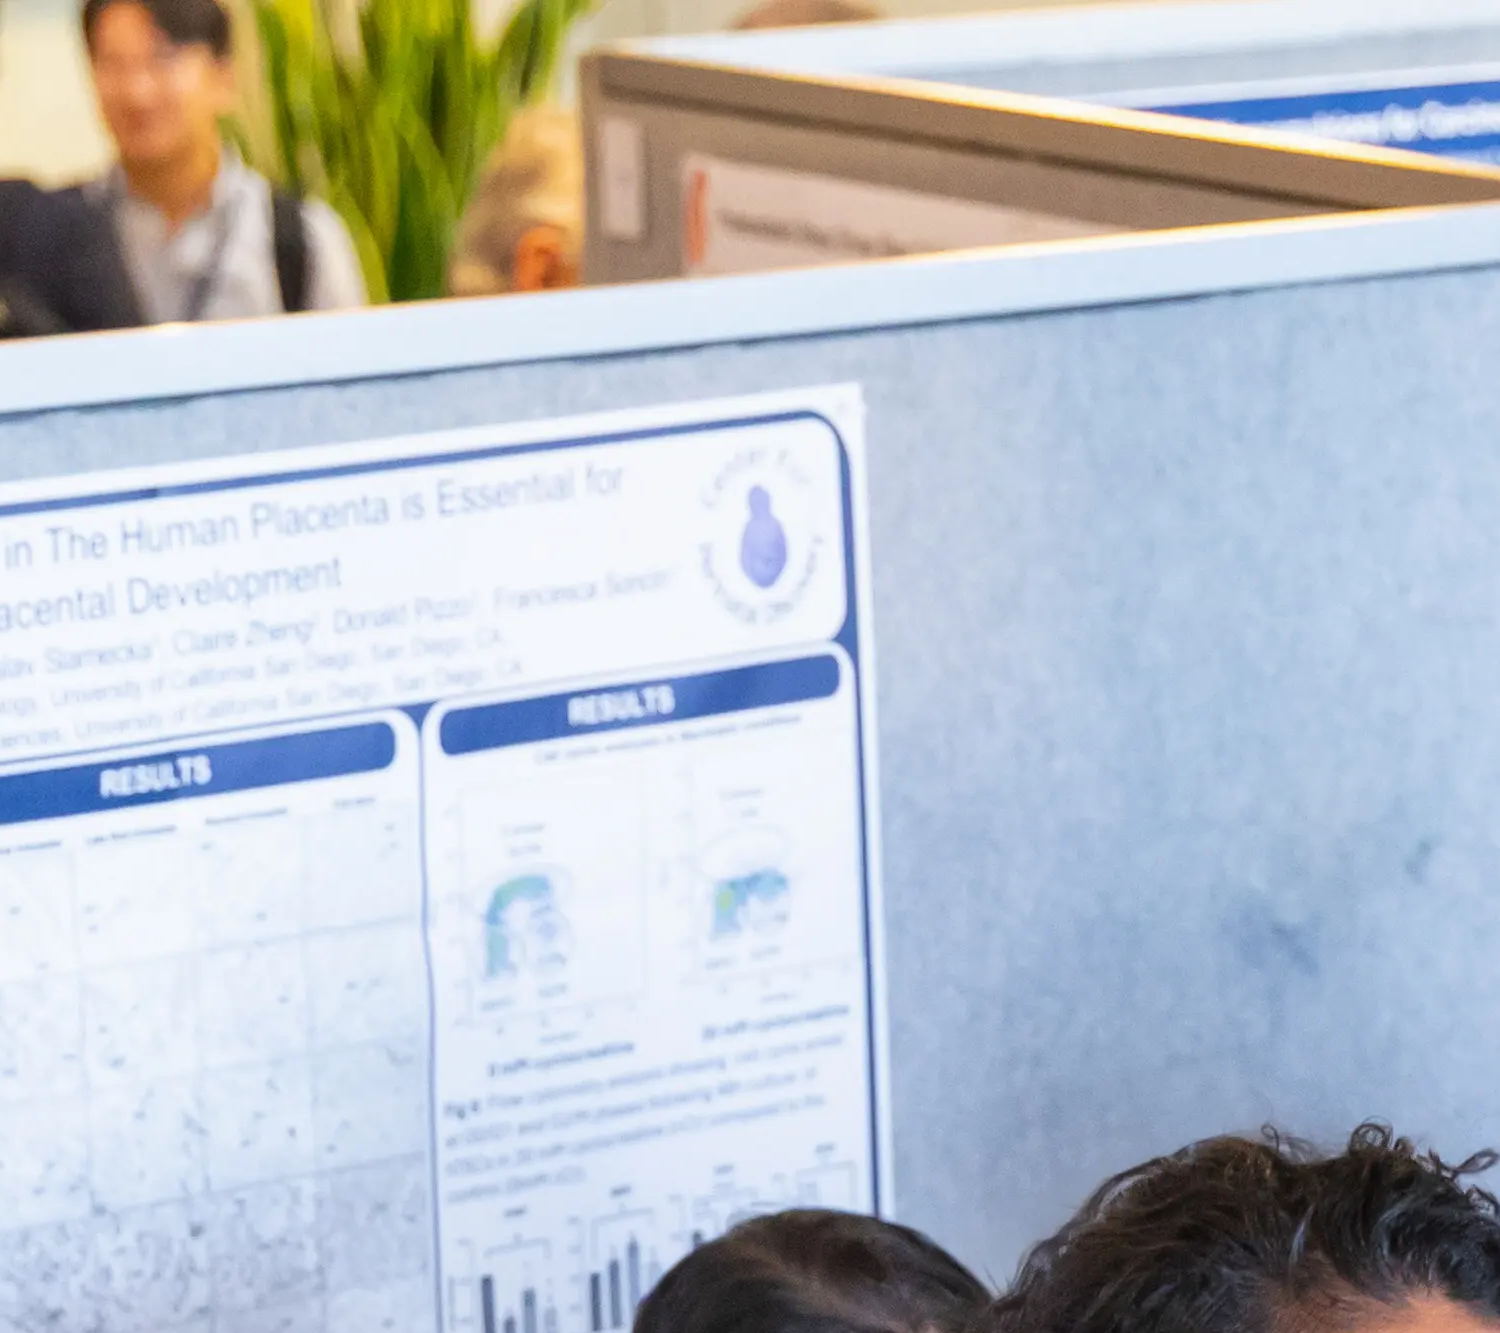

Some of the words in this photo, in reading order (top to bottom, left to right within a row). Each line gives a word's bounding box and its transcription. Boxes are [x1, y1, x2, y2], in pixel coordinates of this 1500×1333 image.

[2, 529, 34, 570] in
[46, 520, 109, 565] The
[118, 504, 240, 556] Human
[248, 486, 390, 540] Placenta
[399, 482, 425, 521] is
[435, 464, 575, 517] Essential
[584, 458, 623, 498] for
[125, 553, 342, 619] Development
[567, 685, 676, 727] RESULTS
[100, 755, 212, 797] RESULTS
